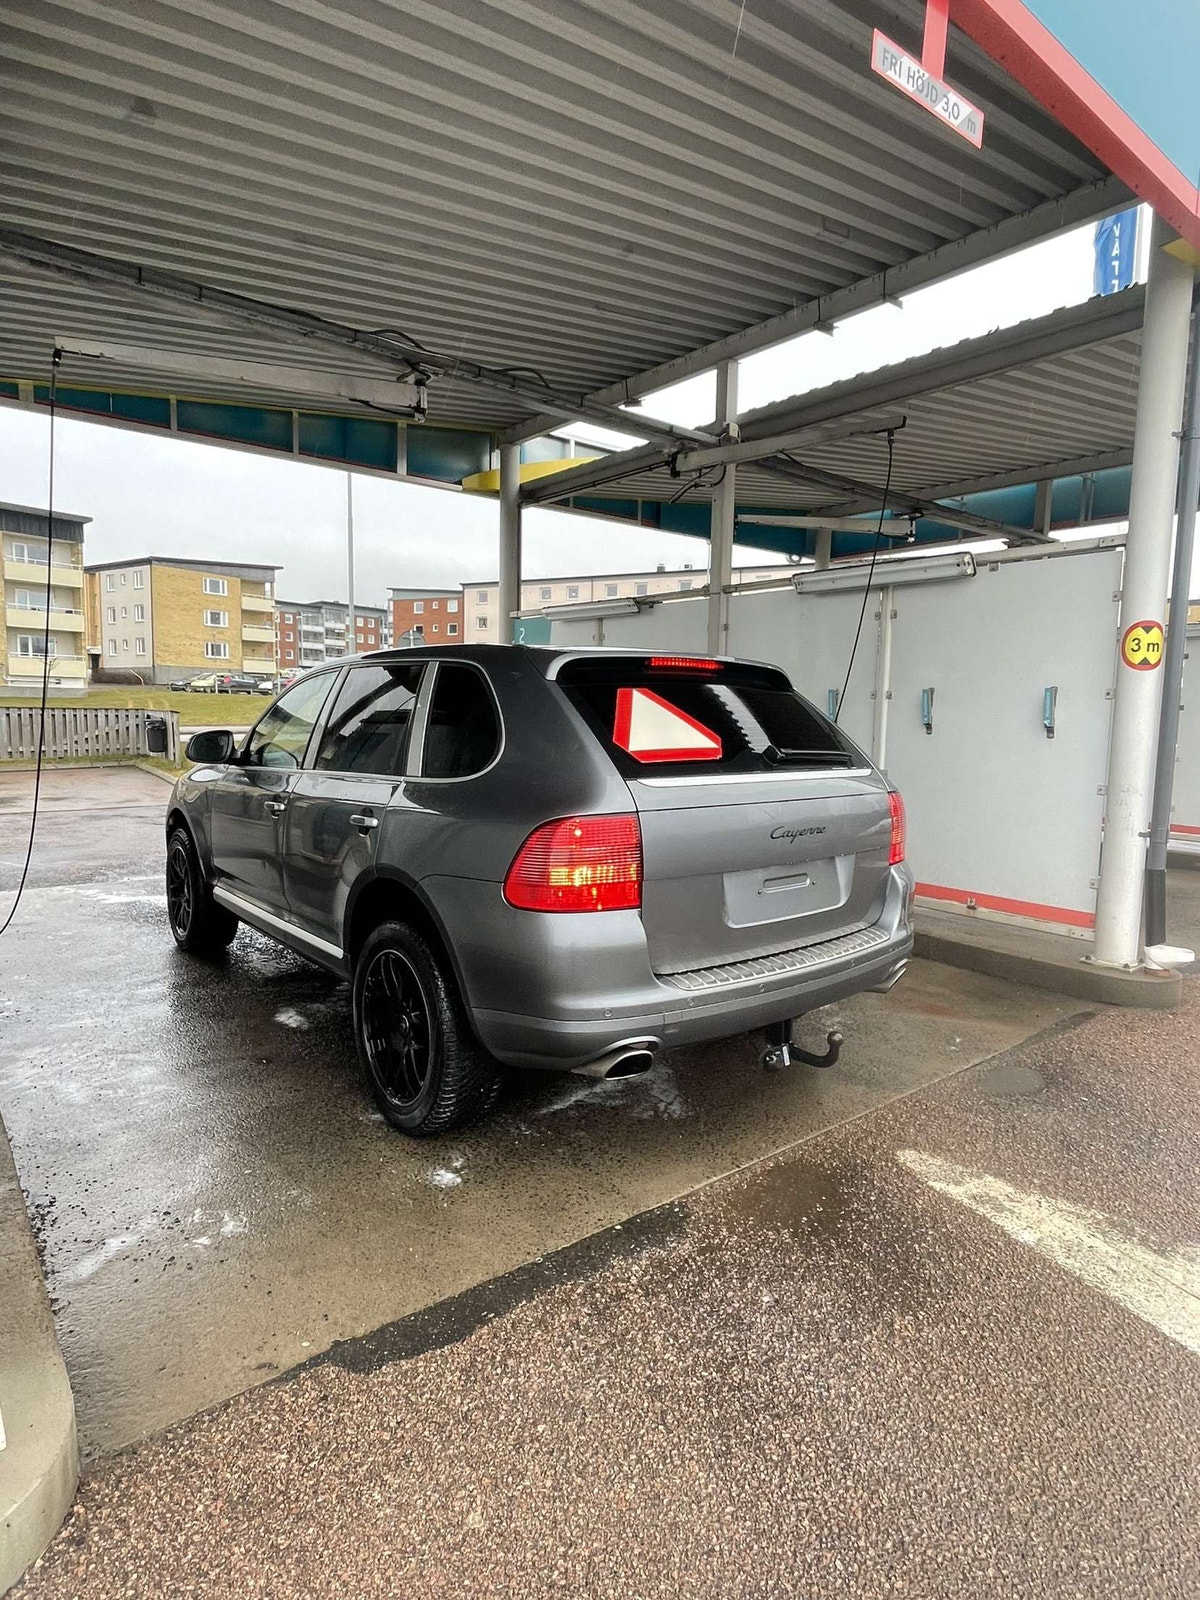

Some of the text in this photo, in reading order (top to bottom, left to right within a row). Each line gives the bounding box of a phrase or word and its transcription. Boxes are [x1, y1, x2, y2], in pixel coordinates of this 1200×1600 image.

[881, 48, 976, 135] FRI HÖJD 3,0 m
[519, 627, 526, 644] 2
[1130, 637, 1160, 653] 3 m
[769, 825, 827, 845] Cayenne
